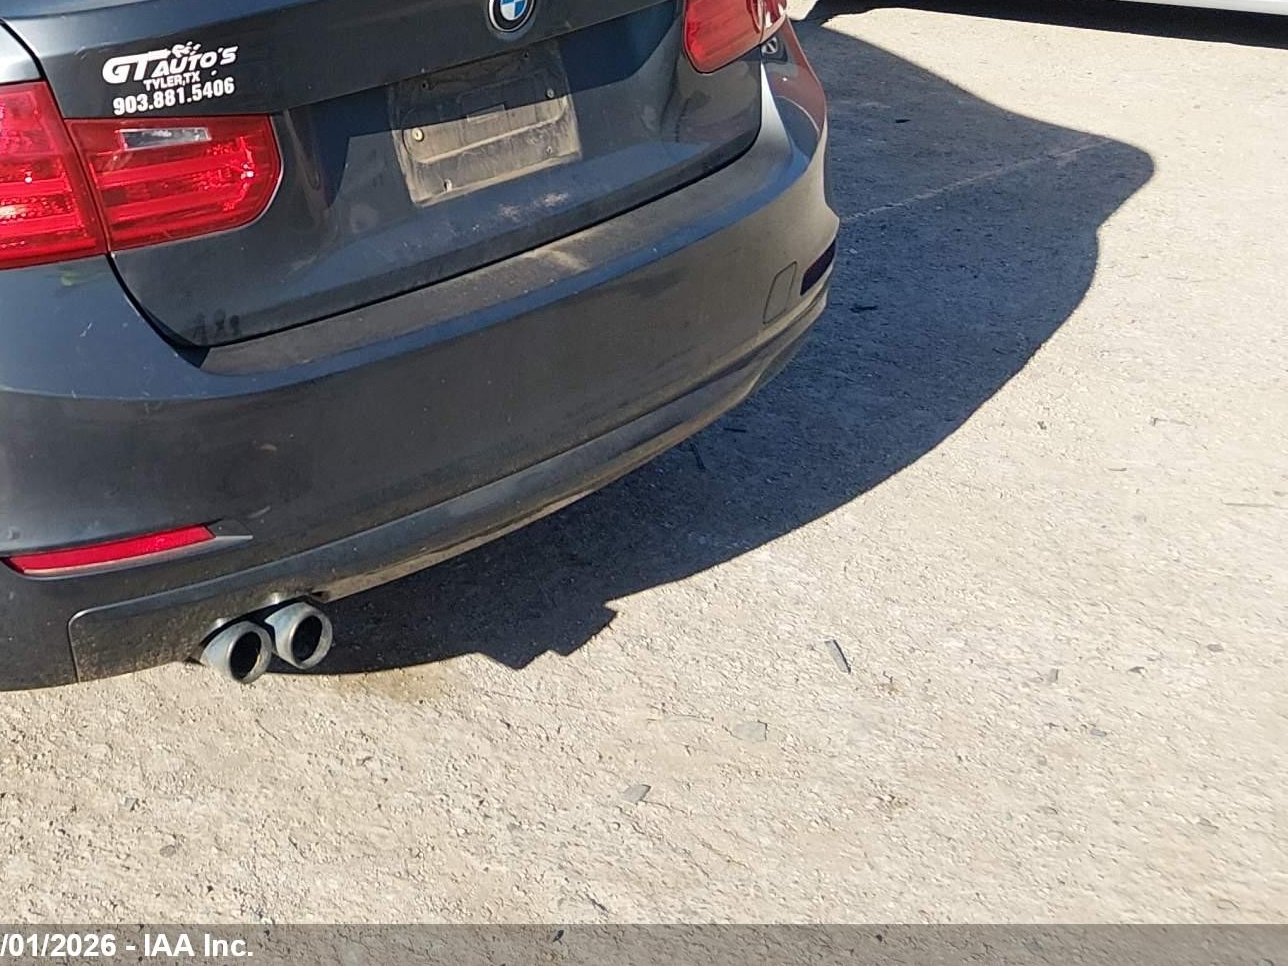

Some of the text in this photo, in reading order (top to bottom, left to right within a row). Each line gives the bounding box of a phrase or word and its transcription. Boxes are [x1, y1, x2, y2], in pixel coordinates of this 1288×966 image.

[102, 45, 239, 84] GT AUTO'S
[112, 76, 235, 116] 903.881.5406
